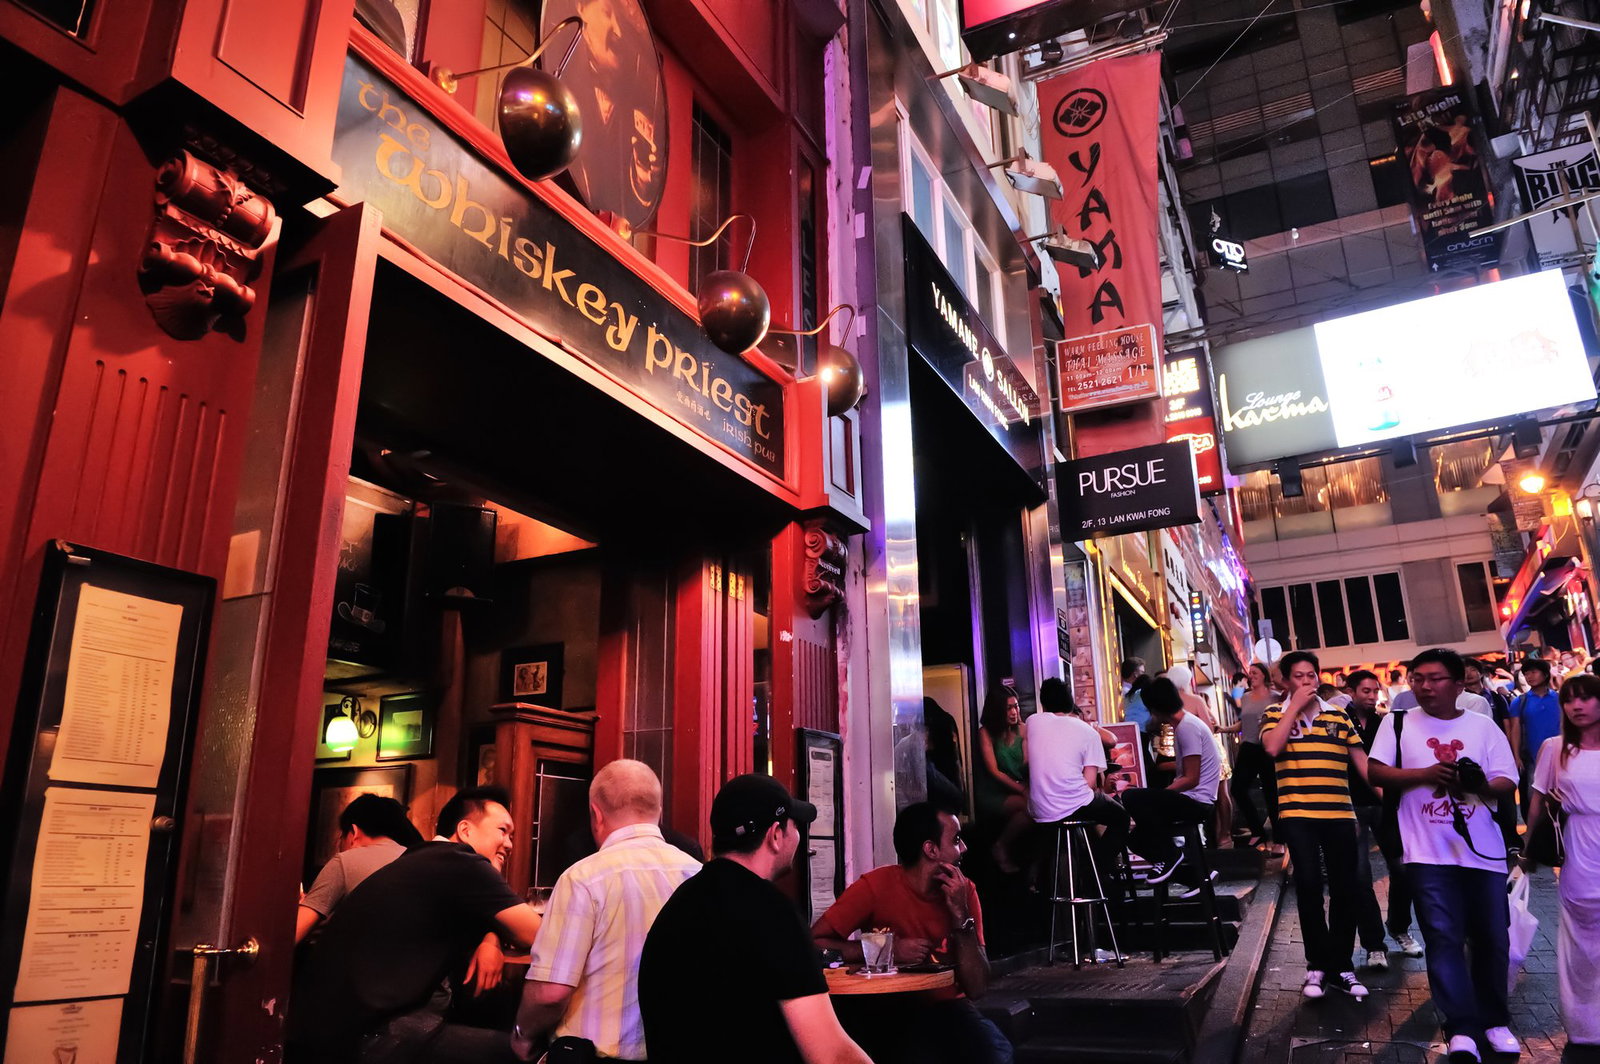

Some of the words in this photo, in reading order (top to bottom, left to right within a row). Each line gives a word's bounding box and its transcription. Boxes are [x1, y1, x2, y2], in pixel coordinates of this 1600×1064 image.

[357, 79, 431, 153] the
[1547, 159, 1567, 170] THE
[931, 281, 979, 361] YAMANE
[1064, 344, 1085, 357] WARM
[1087, 339, 1118, 352] FEELING
[1120, 332, 1144, 346] HOUSE
[1065, 356, 1091, 372] THAI
[1095, 345, 1146, 367] MASSAGE
[1127, 363, 1148, 379] 1/F
[1077, 380, 1099, 391] 2521
[1101, 375, 1123, 387] 2621
[1219, 373, 1329, 432] karma
[1241, 391, 1302, 411] Lounge
[1079, 458, 1167, 496] PURSUE
[1110, 489, 1136, 499] FASHION
[1097, 517, 1107, 526] 13
[1109, 514, 1125, 525] LAN
[1126, 510, 1147, 522] KWAI
[1148, 507, 1171, 519] FONG
